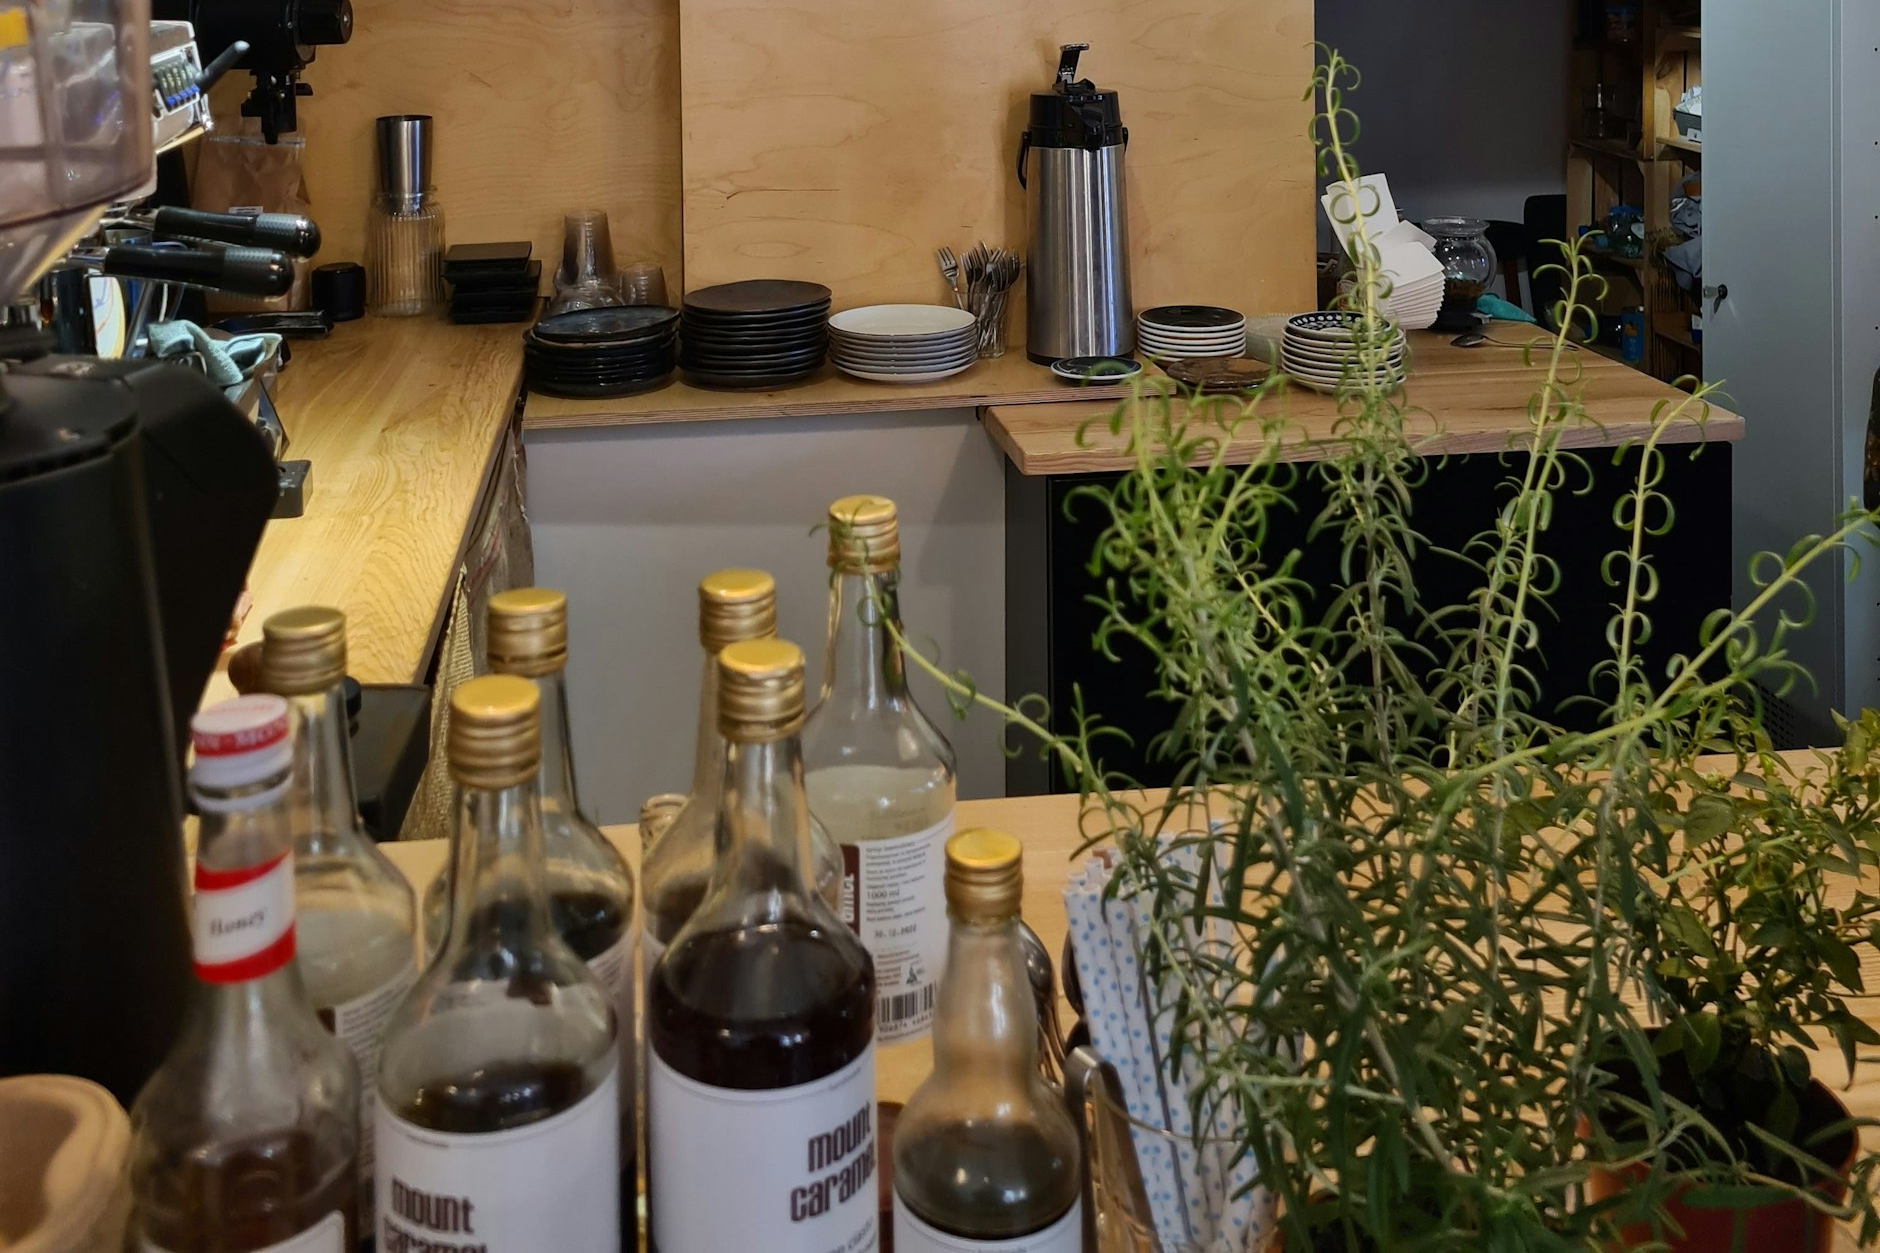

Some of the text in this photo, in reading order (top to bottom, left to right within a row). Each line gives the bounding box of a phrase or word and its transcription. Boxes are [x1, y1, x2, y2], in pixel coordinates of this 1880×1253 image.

[808, 1099, 871, 1173] mount
[392, 1175, 475, 1235] mount
[791, 1136, 876, 1223] carame
